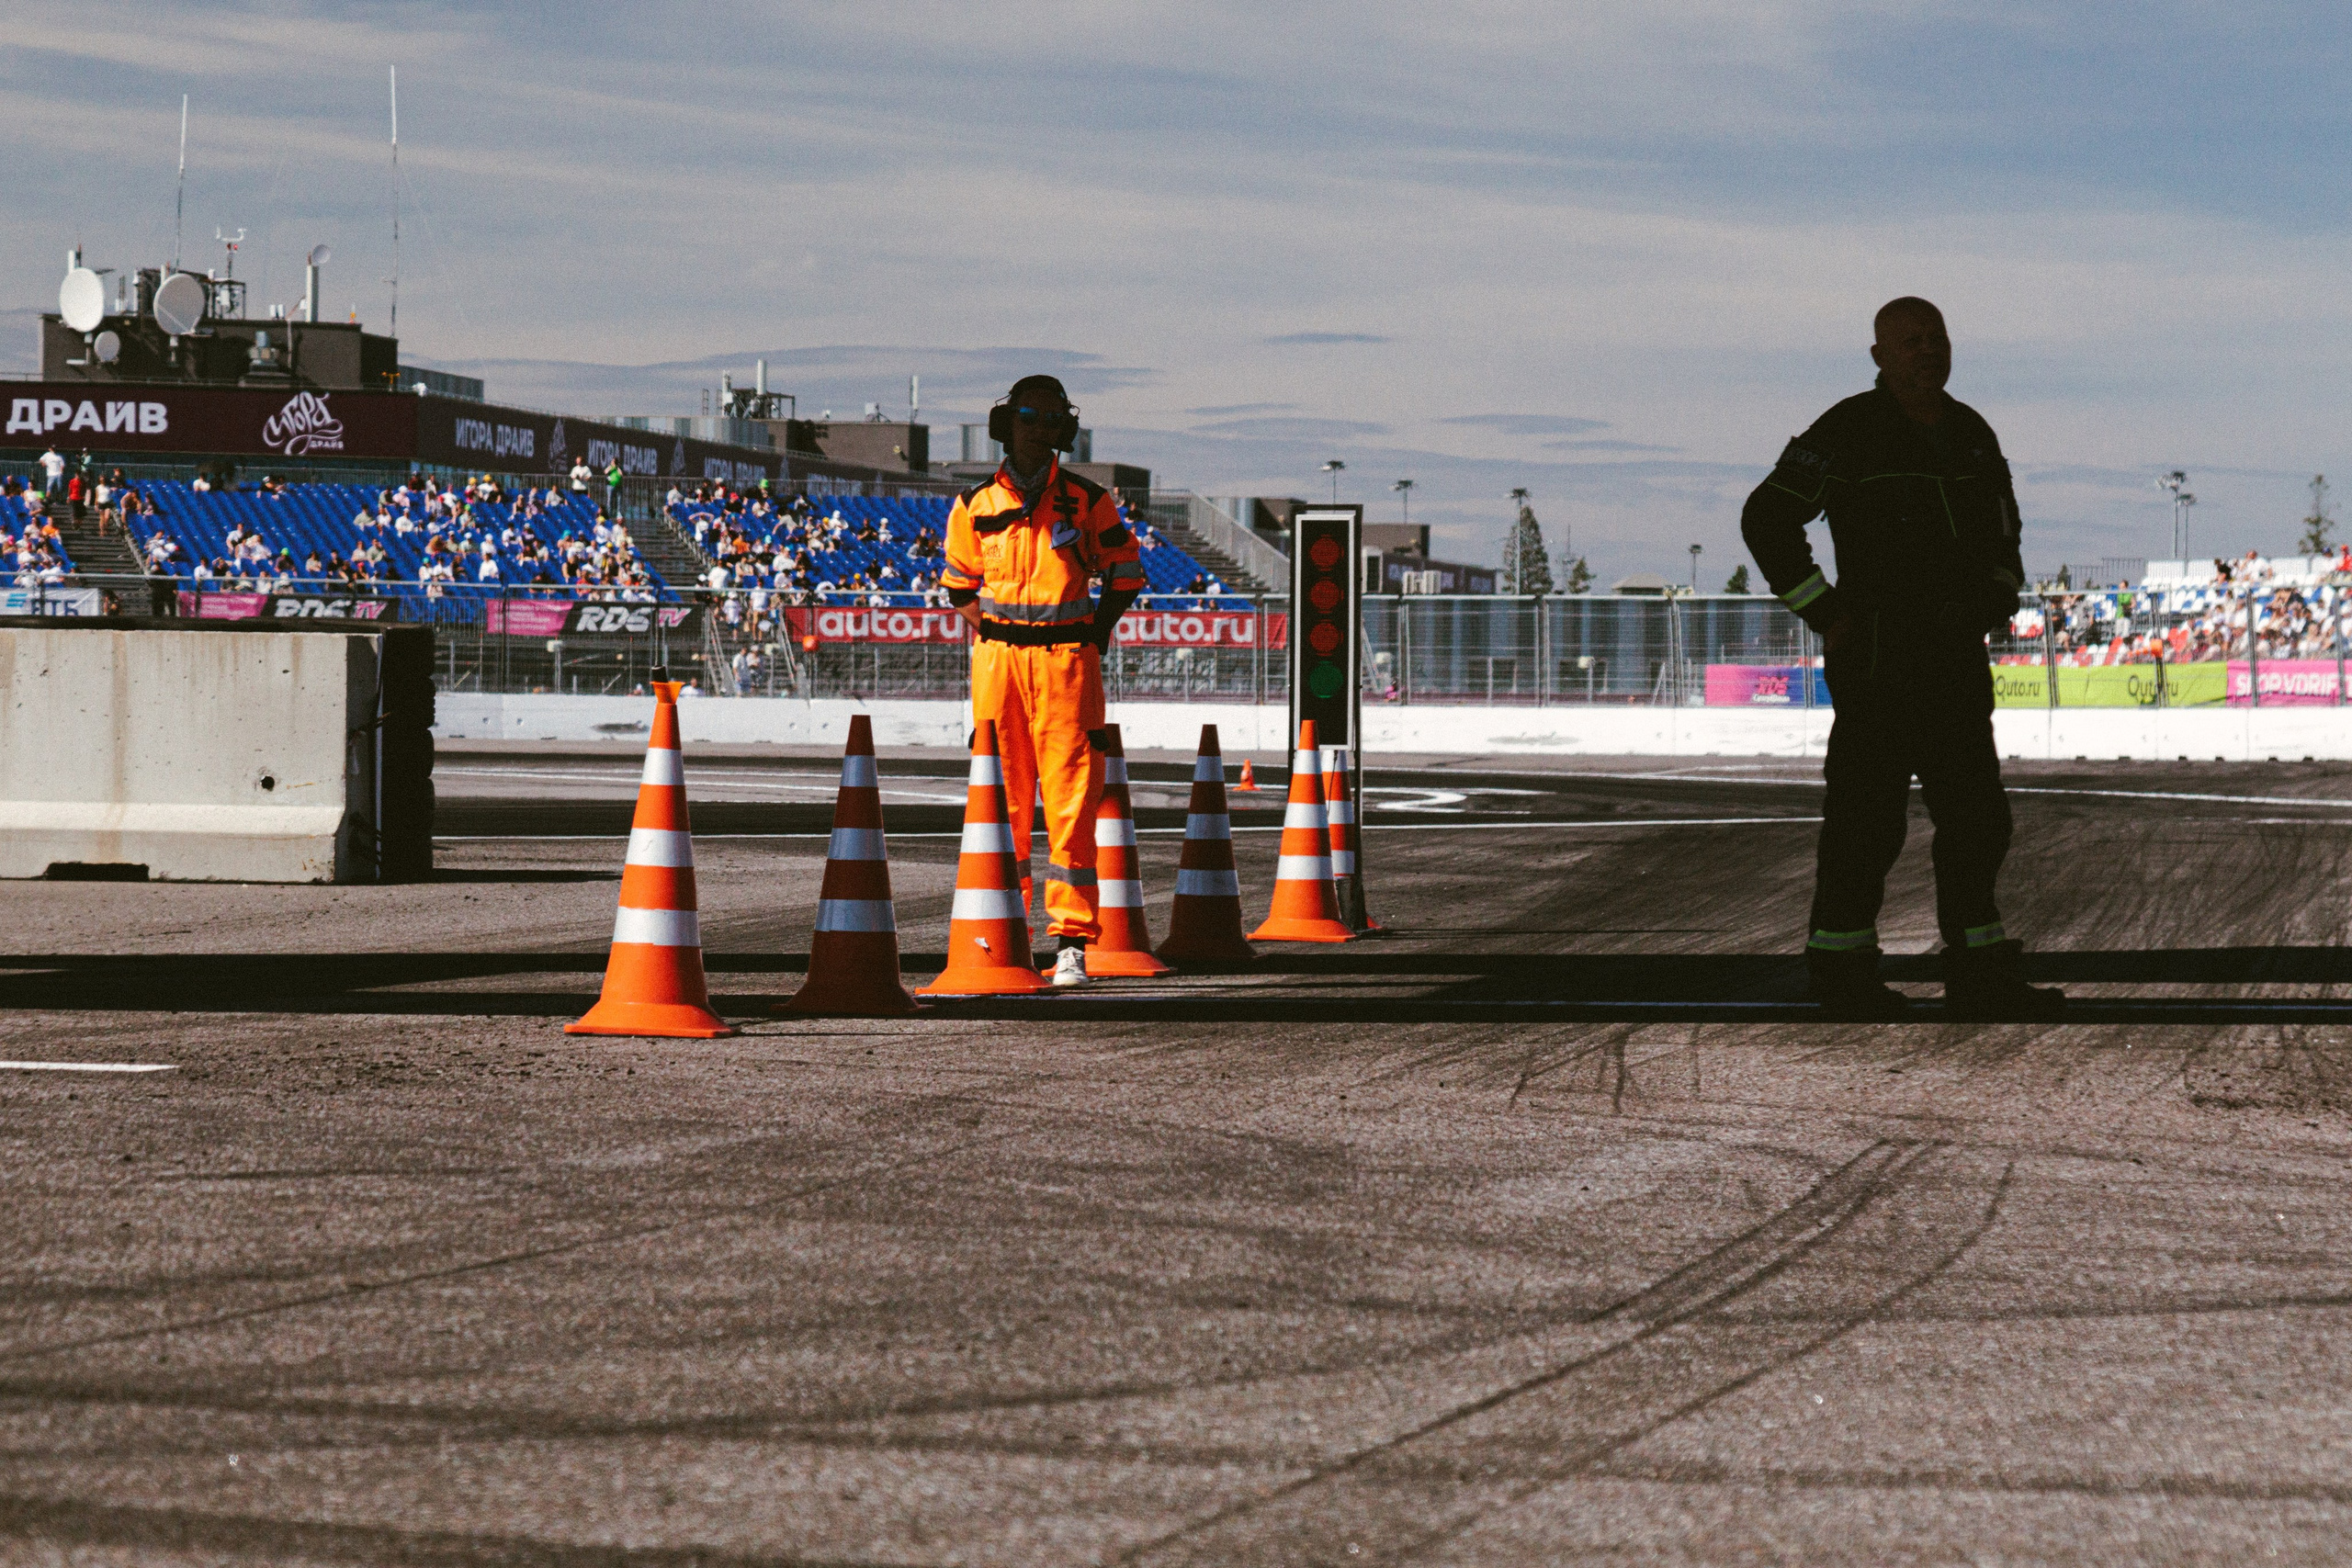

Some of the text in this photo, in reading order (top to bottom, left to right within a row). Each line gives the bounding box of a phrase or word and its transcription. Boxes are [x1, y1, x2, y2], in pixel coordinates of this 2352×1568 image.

[6, 398, 168, 434] ДРАЙВ
[456, 418, 493, 451] ИГОРА
[495, 424, 534, 457] ДРАЙВ
[623, 445, 657, 475] ДРАЙВ
[355, 601, 387, 619] TV
[576, 606, 652, 632] RDS
[658, 607, 692, 627] TV
[819, 610, 964, 638] auto.ru
[1116, 614, 1253, 642] auto.ru
[1996, 675, 2040, 702] Quto.ru
